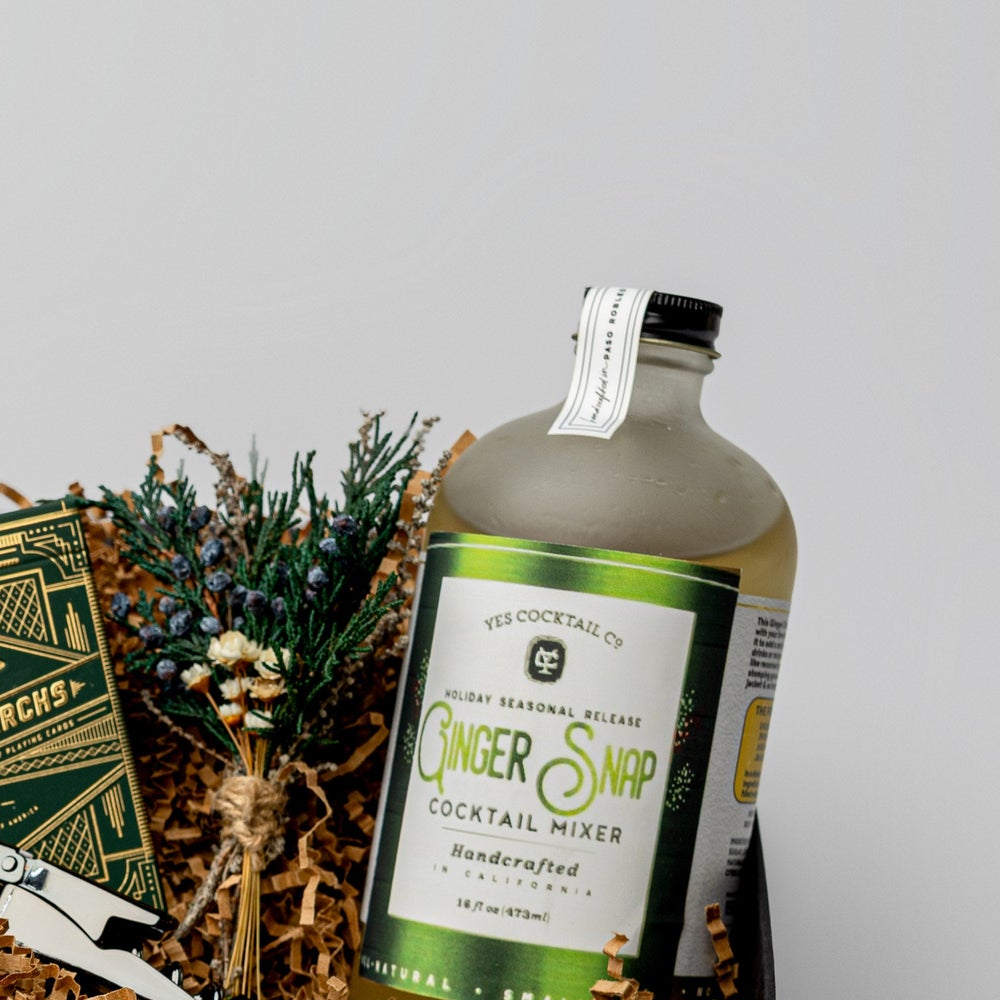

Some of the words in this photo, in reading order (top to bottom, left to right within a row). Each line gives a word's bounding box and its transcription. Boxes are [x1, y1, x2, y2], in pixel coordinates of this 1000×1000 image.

[603, 331, 613, 360] PASO
[608, 288, 627, 324] ROBLES
[484, 612, 513, 631] YES
[516, 609, 601, 638] COCKTAIL
[444, 688, 493, 705] HOLIDAY
[499, 696, 575, 719] SEASONAL
[583, 709, 643, 728] RELEASE
[5, 733, 43, 755] PLAYING
[45, 718, 75, 738] CARDS
[417, 700, 533, 796] GINGER
[536, 721, 657, 817] SNAP
[428, 798, 539, 833] COCKTAIL
[551, 818, 624, 845] MIXER
[450, 843, 580, 877] Handcrafted
[433, 863, 449, 874] IN
[465, 869, 593, 897] CALIFORNIA
[456, 897, 472, 910] 16
[471, 900, 485, 912] fl
[486, 904, 500, 915] oz
[500, 904, 551, 924] (473ml)
